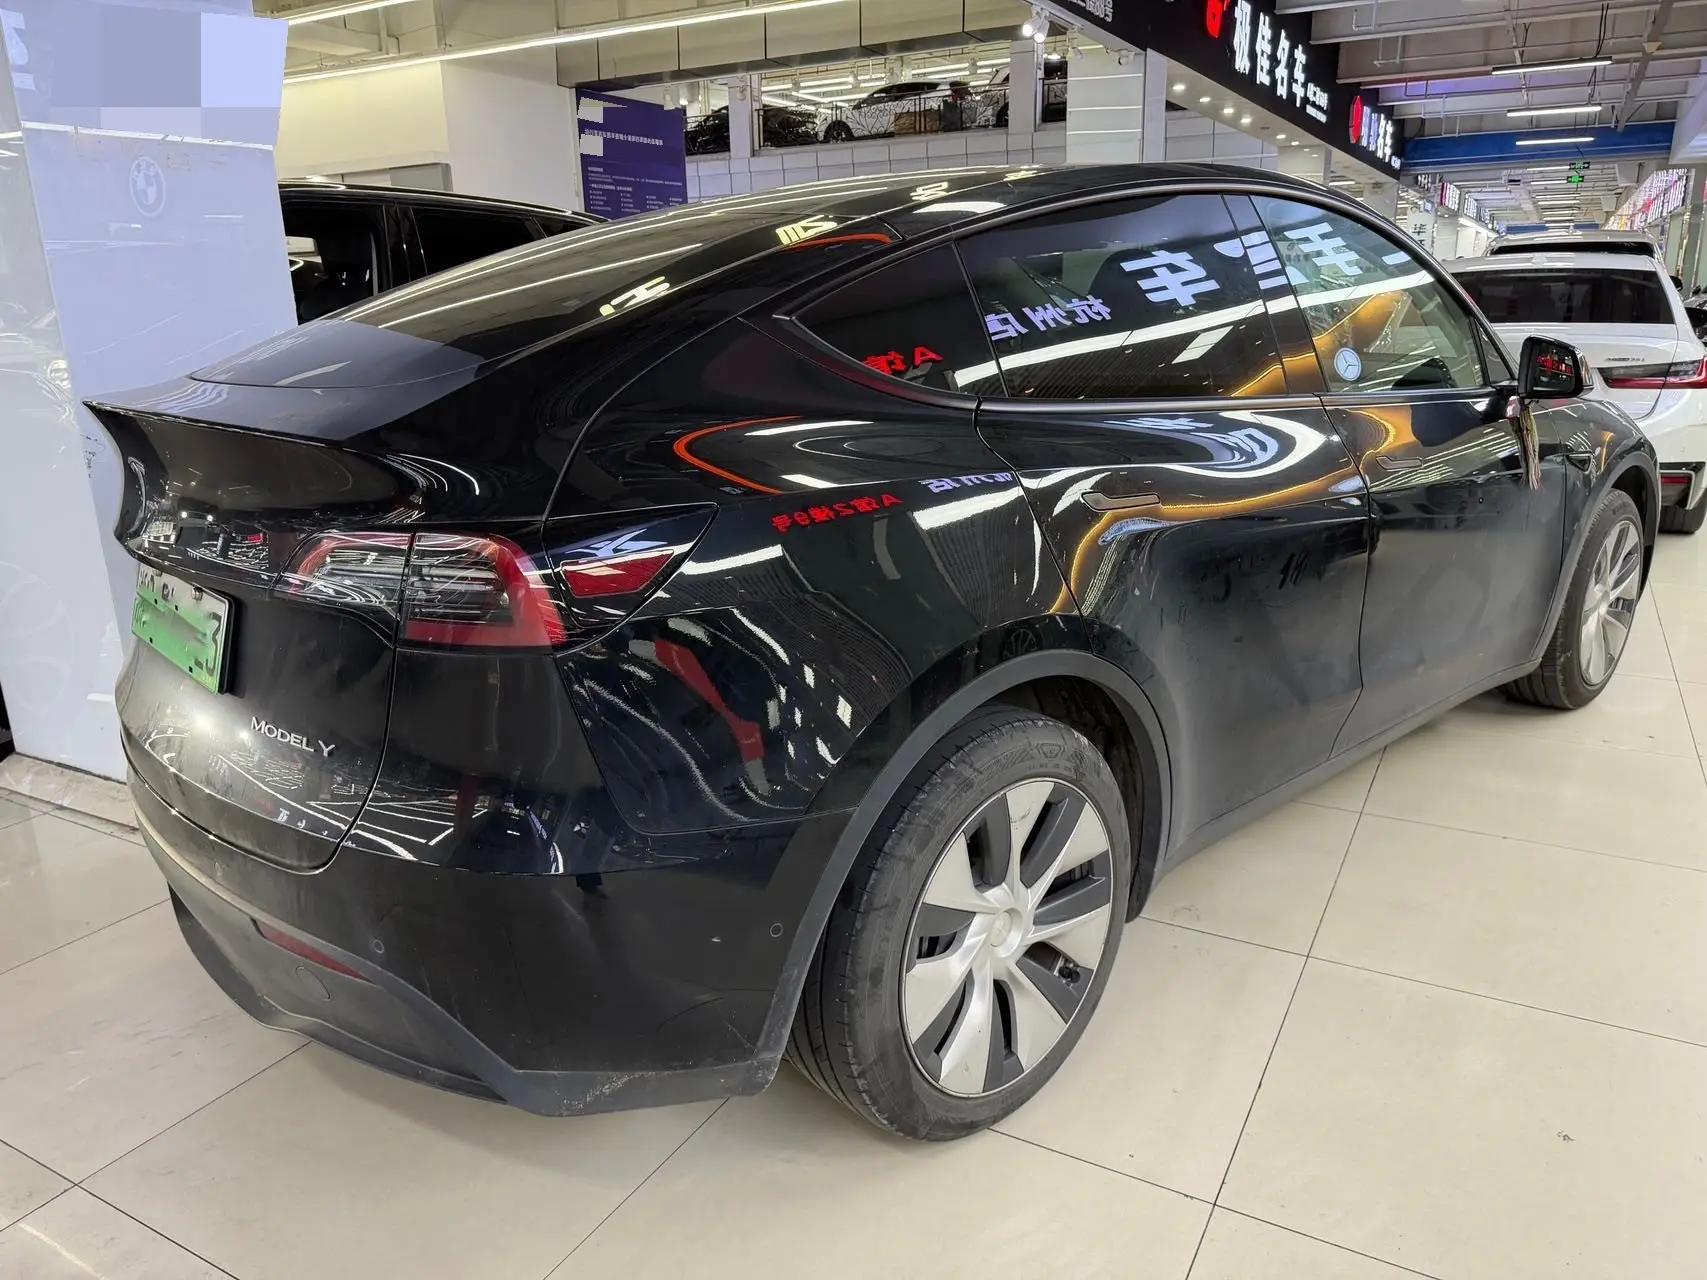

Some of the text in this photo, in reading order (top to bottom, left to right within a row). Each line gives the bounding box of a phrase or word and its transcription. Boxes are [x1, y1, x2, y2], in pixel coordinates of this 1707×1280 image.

[1233, 0, 1307, 107] 极佳名车
[250, 716, 336, 758] MODEL Y
